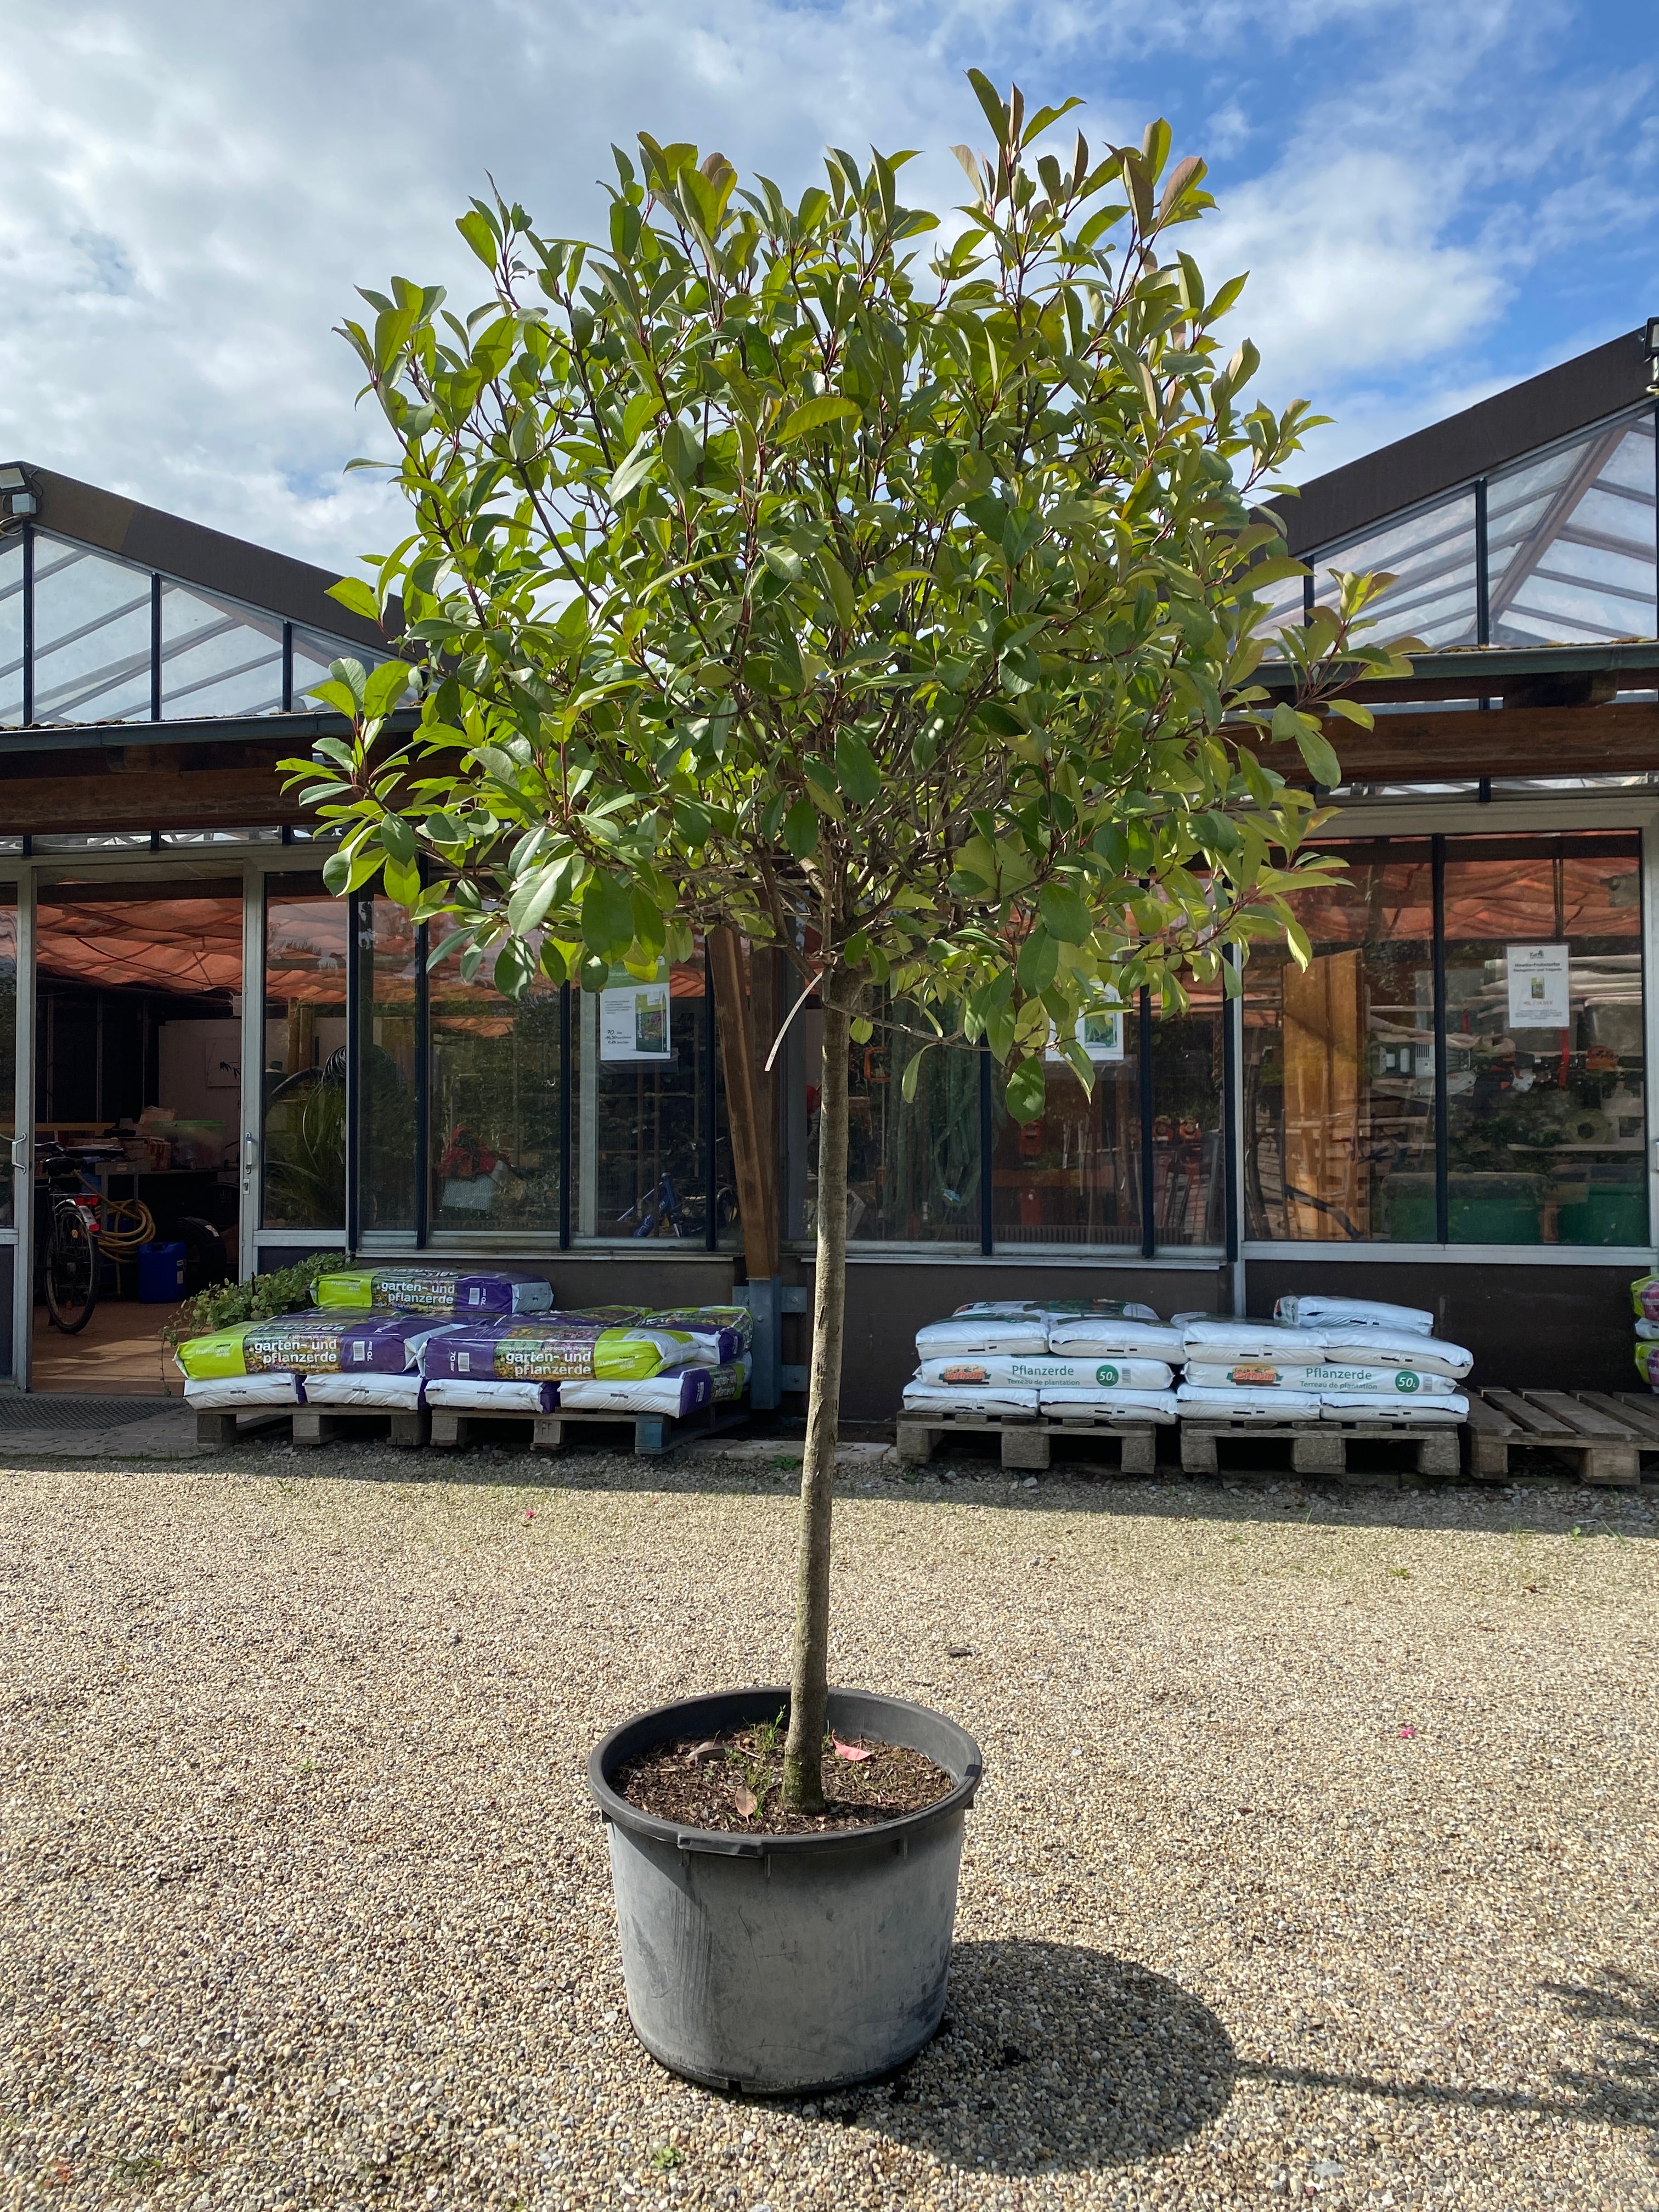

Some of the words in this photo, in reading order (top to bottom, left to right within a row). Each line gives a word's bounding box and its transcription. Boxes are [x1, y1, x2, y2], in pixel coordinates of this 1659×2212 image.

[381, 1282, 428, 1291] garten-
[431, 1285, 455, 1294] und
[388, 1292, 454, 1304] pflanzerde
[481, 1296, 486, 1306] 70
[255, 1340, 308, 1353] garten-
[312, 1339, 337, 1350] und
[263, 1352, 337, 1364] pflanzerde
[367, 1351, 373, 1362] 70
[450, 1351, 456, 1362] 70
[506, 1351, 560, 1364] garten-
[565, 1351, 591, 1362] und
[515, 1364, 591, 1376] pflanzerde
[1012, 1365, 1074, 1376] Pflanzerde
[1306, 1368, 1372, 1380] Pflanzerde
